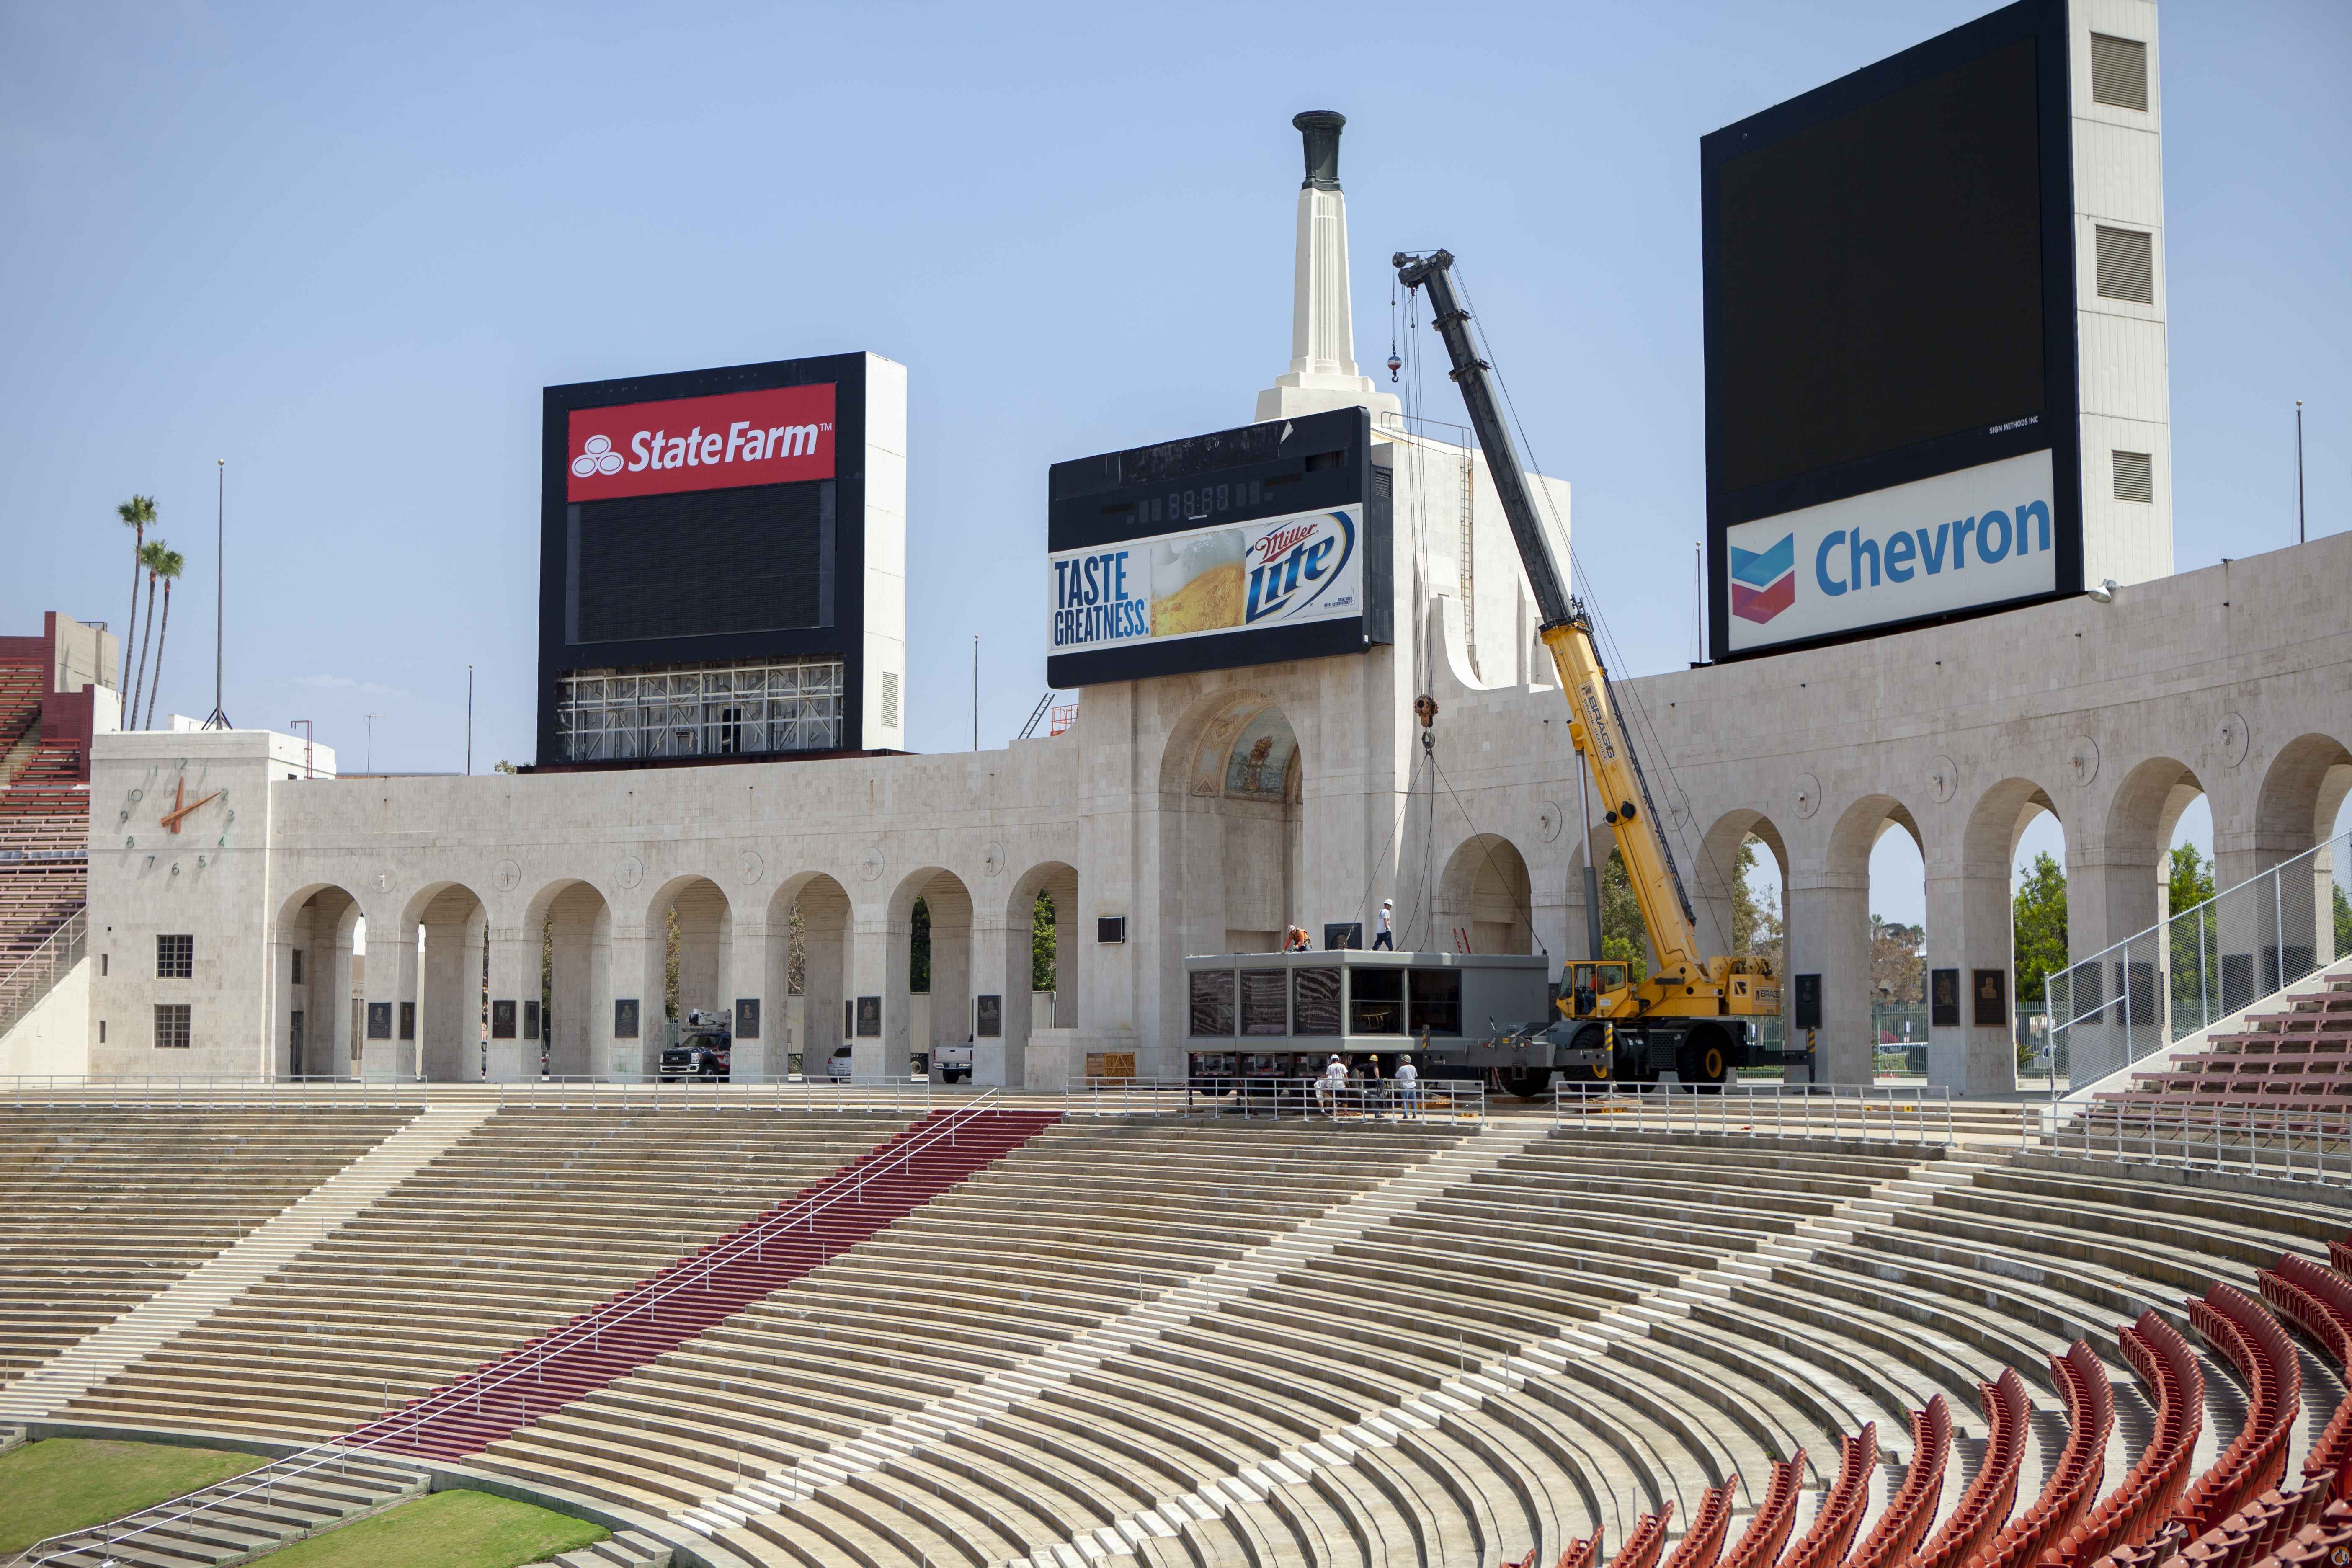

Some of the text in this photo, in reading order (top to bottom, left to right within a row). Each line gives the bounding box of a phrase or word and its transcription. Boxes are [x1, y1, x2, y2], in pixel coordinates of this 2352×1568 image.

[1990, 415, 2038, 434] SIGN METHODS INC
[1255, 523, 1318, 565] Miller
[1816, 500, 2051, 597] Chevron
[1055, 551, 1129, 609] TASTE
[1246, 535, 1335, 625] Lite
[1054, 599, 1149, 646] GREATNESS.
[1550, 644, 1562, 675] GROVE
[1583, 699, 1608, 761] CRANE SERVICE
[1588, 696, 1615, 758] BRAGG
[174, 757, 188, 770] 12
[128, 789, 143, 802] 10
[120, 810, 128, 824] 9
[227, 810, 235, 822] 3
[126, 836, 134, 849] 8
[218, 836, 225, 847] 4
[147, 856, 155, 868] 7
[172, 862, 180, 875] 6
[199, 855, 207, 868] 5
